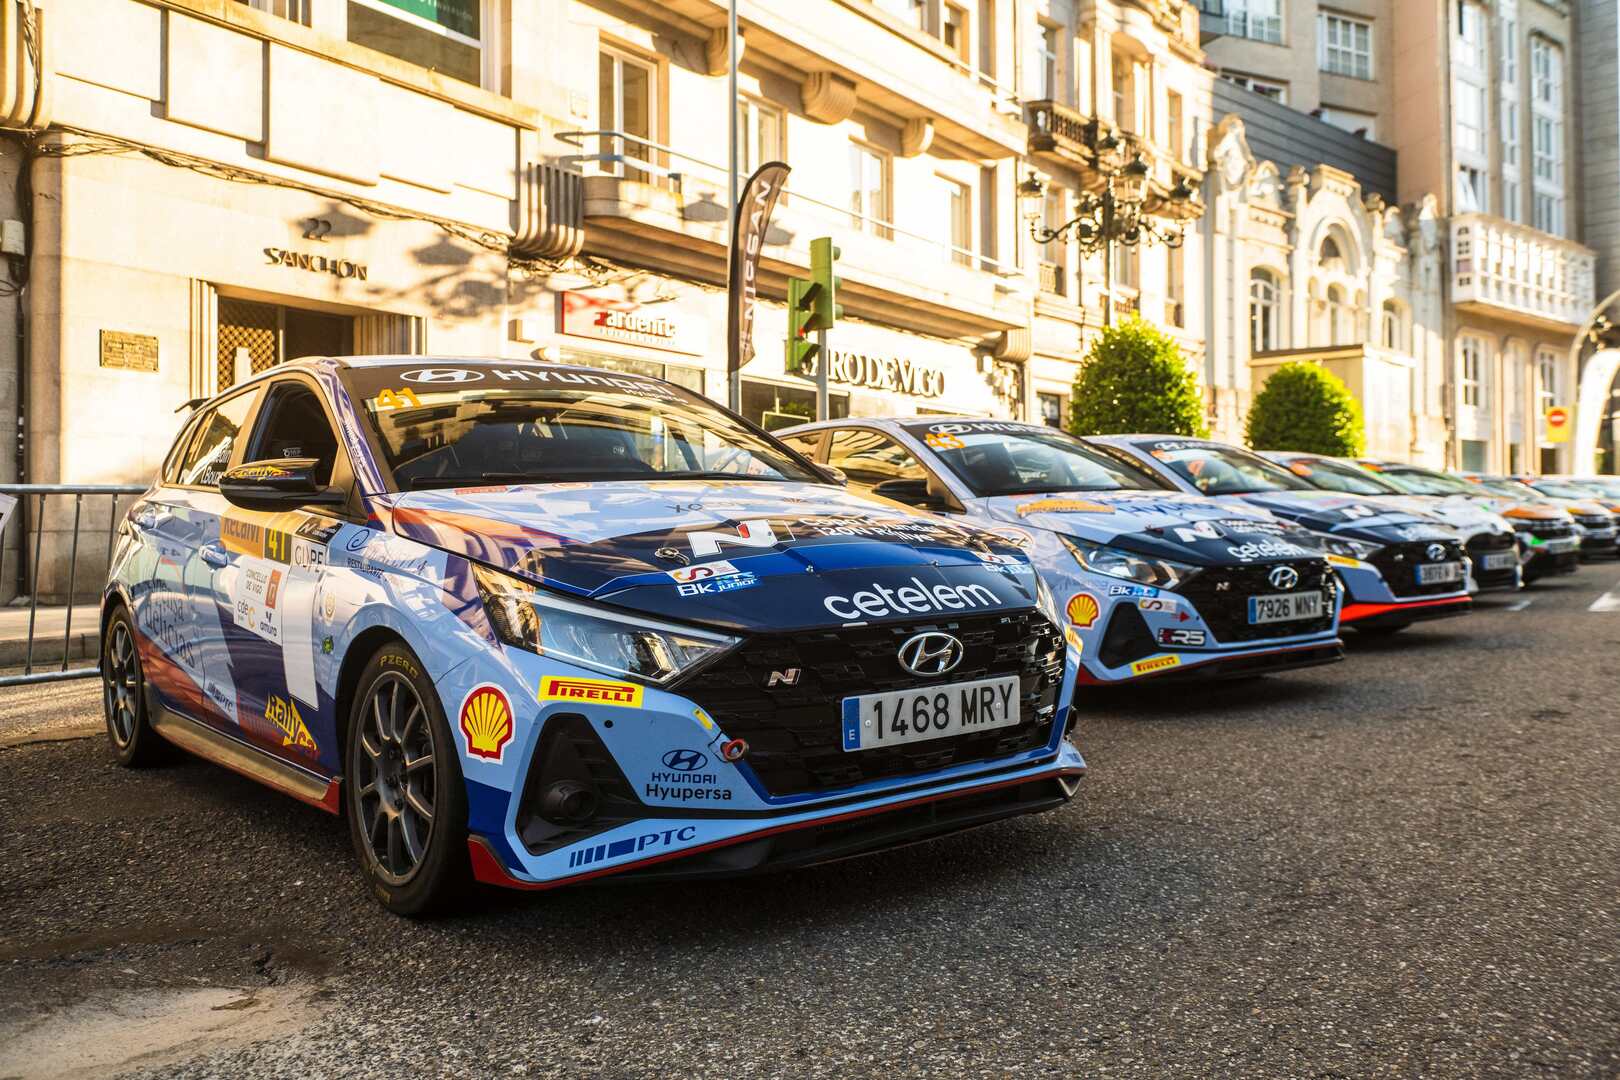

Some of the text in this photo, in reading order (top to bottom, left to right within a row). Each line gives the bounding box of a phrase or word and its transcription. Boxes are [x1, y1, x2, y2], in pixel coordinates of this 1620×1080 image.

[302, 218, 332, 243] 22
[745, 181, 771, 321] NISSAN
[492, 369, 676, 397] HYUNDAI
[377, 387, 422, 409] 41
[925, 432, 966, 449] 43
[798, 517, 859, 528] Copa
[269, 528, 285, 561] 41
[1226, 539, 1306, 558] cetelem
[718, 578, 758, 593] junior
[823, 576, 1002, 620] cetelem
[1258, 598, 1290, 620] 7926
[548, 679, 635, 703] PIRELLI
[848, 682, 1014, 741] E 1468 MRY
[651, 771, 717, 785] HYUNDAI
[645, 782, 732, 802] Hyupersa
[637, 826, 696, 852] PTC
